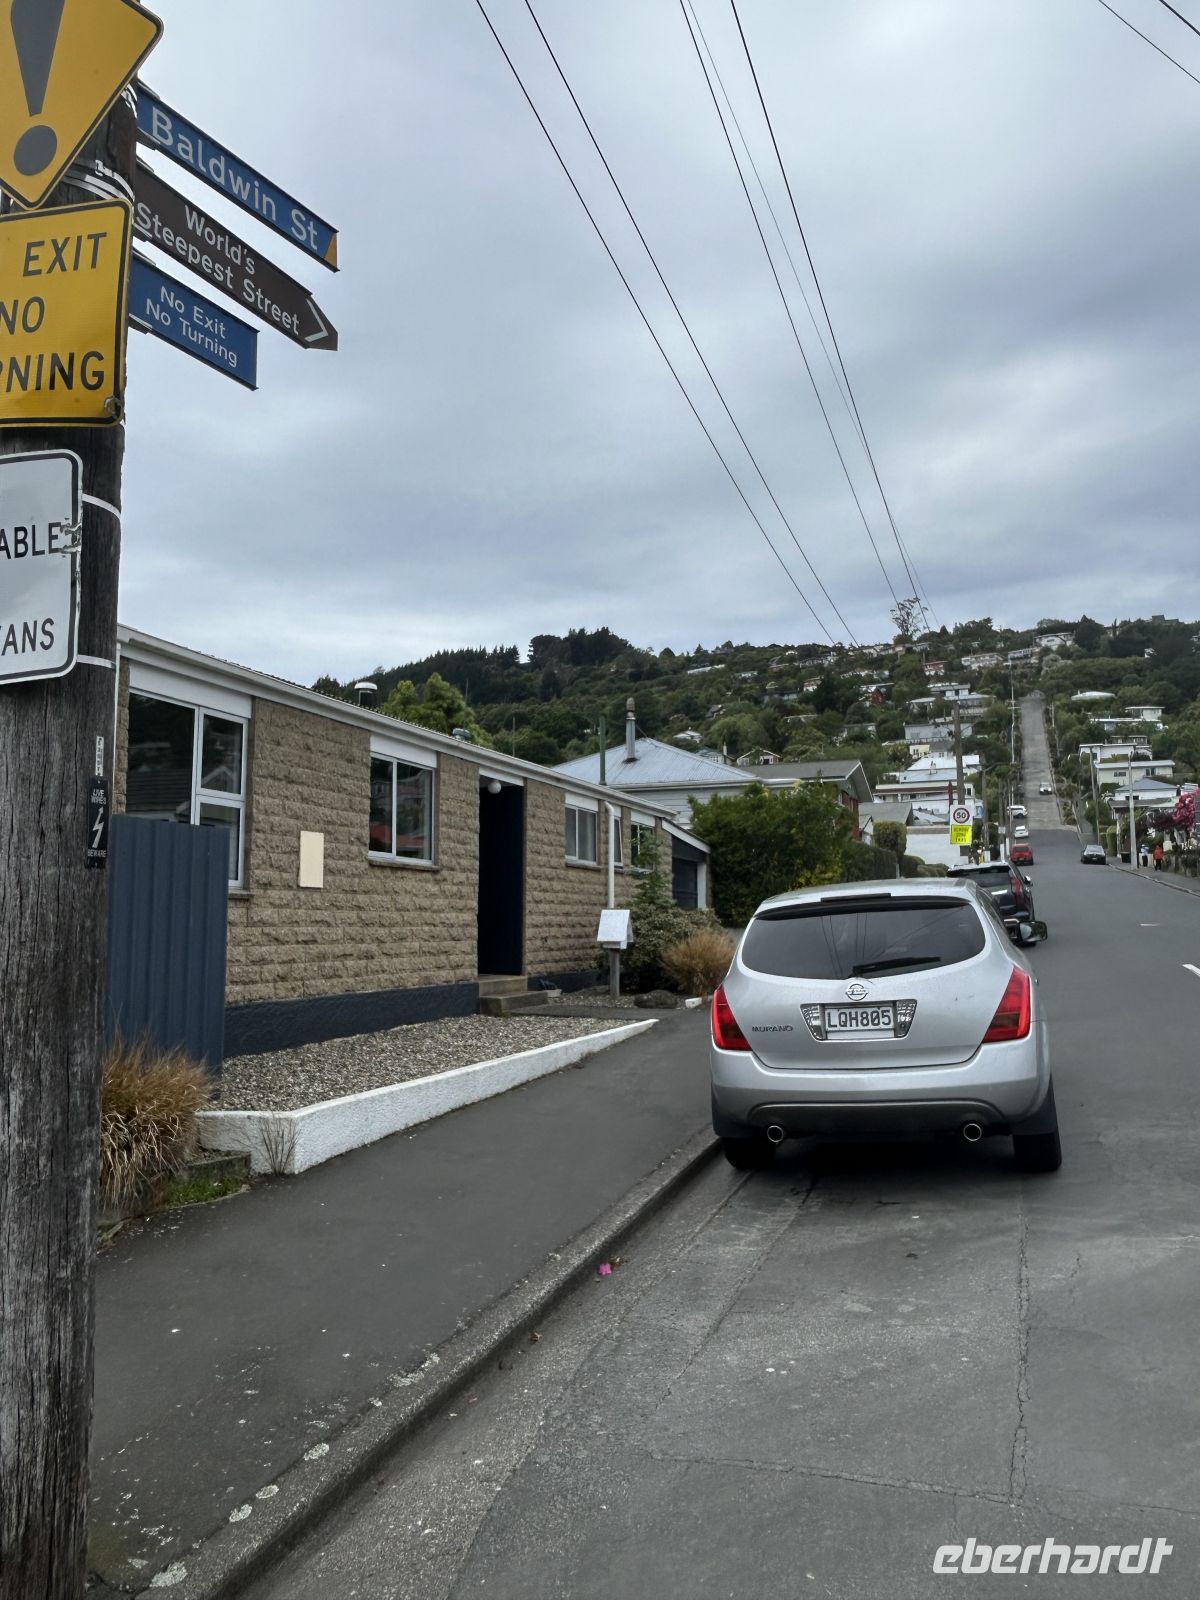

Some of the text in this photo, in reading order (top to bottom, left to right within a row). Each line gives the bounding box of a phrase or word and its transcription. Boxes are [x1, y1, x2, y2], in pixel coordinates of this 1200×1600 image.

[152, 106, 318, 250] Baldwin St
[23, 232, 107, 277] EXIT
[185, 205, 255, 275] World's
[136, 202, 300, 335] Steepest Street
[0, 296, 45, 335] NO
[146, 298, 237, 367] No Turning
[161, 286, 226, 339] No Exit
[0, 351, 104, 393] NING
[0, 617, 55, 656] ANS
[92, 788, 104, 797] LIVE
[956, 811, 967, 819] 50
[87, 848, 107, 858] BEWARE
[751, 1025, 794, 1033] MURANO
[827, 1009, 892, 1028] LQH805
